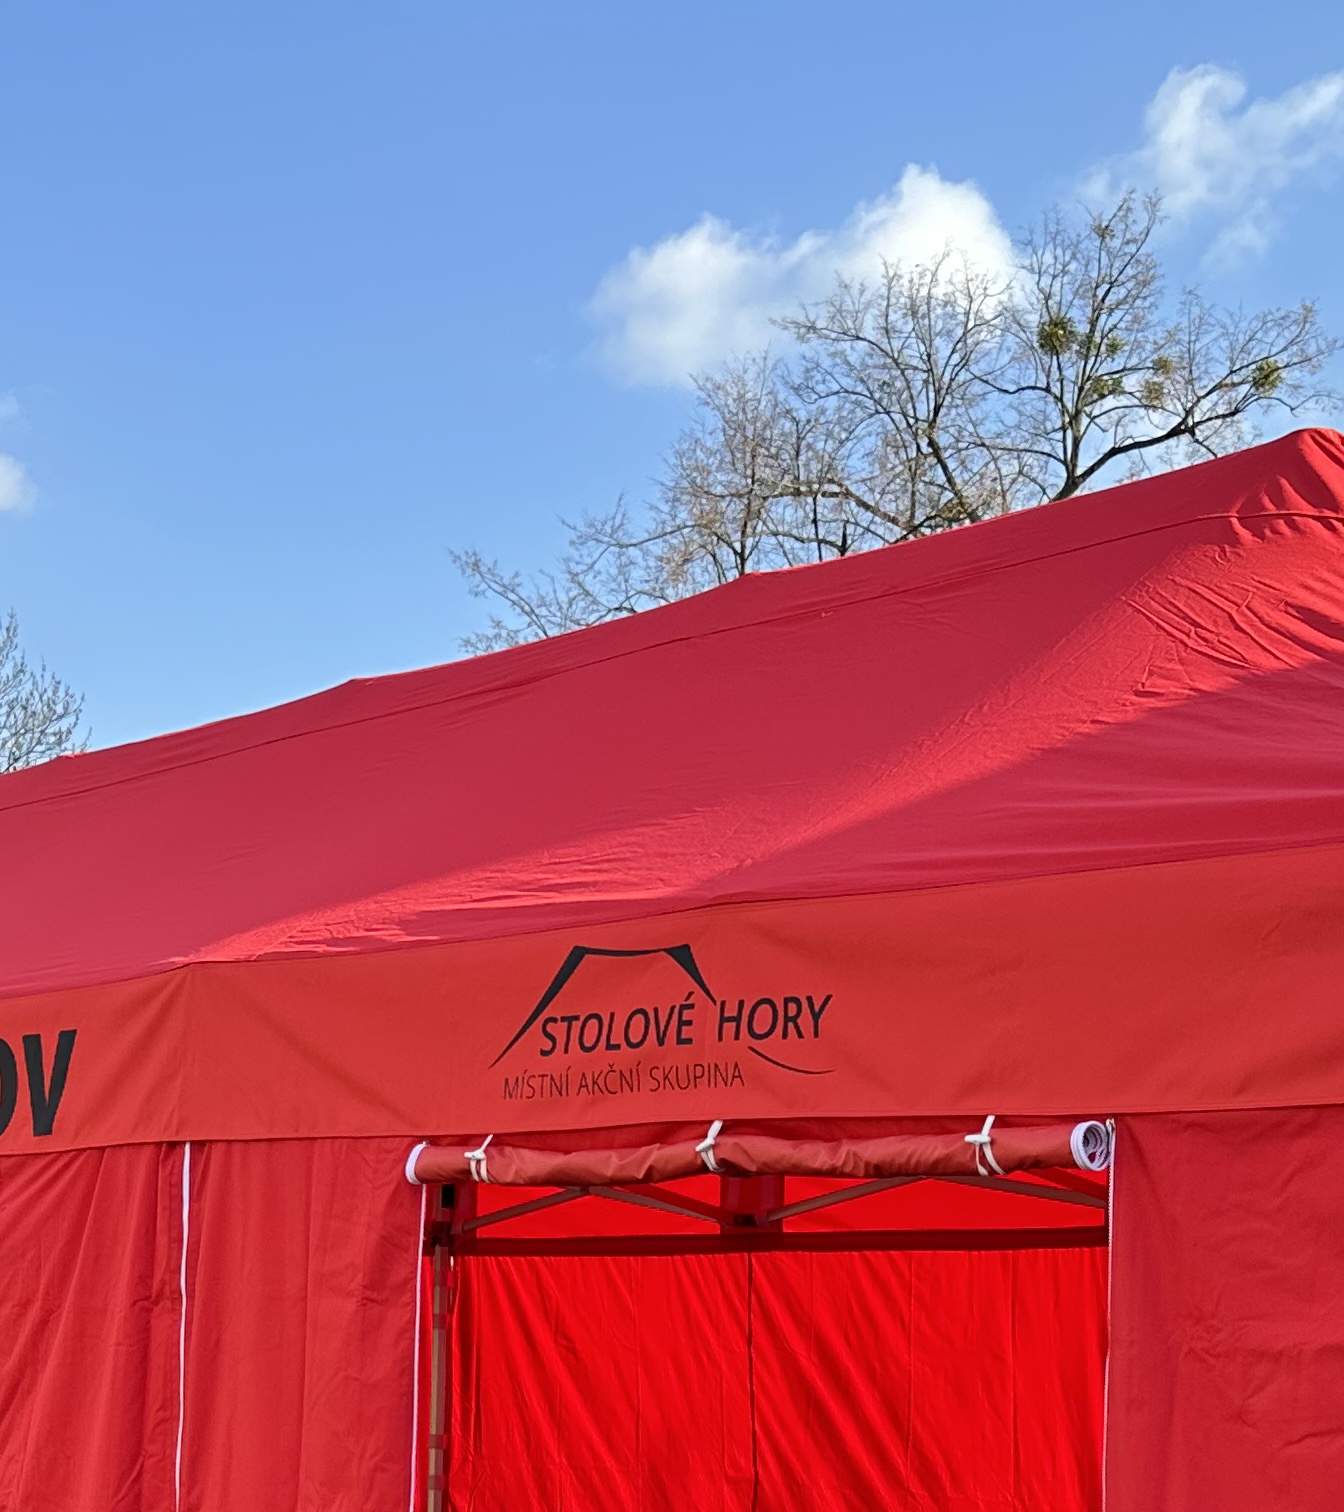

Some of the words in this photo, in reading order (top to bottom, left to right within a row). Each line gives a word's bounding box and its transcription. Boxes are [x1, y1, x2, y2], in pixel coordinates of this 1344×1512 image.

[540, 991, 695, 1056] STOLOVÉ
[717, 994, 833, 1042] HORY
[504, 1065, 572, 1101] MÍSTNÍ
[576, 1060, 642, 1096] AKČNÍ
[649, 1060, 746, 1093] SKUPINA
